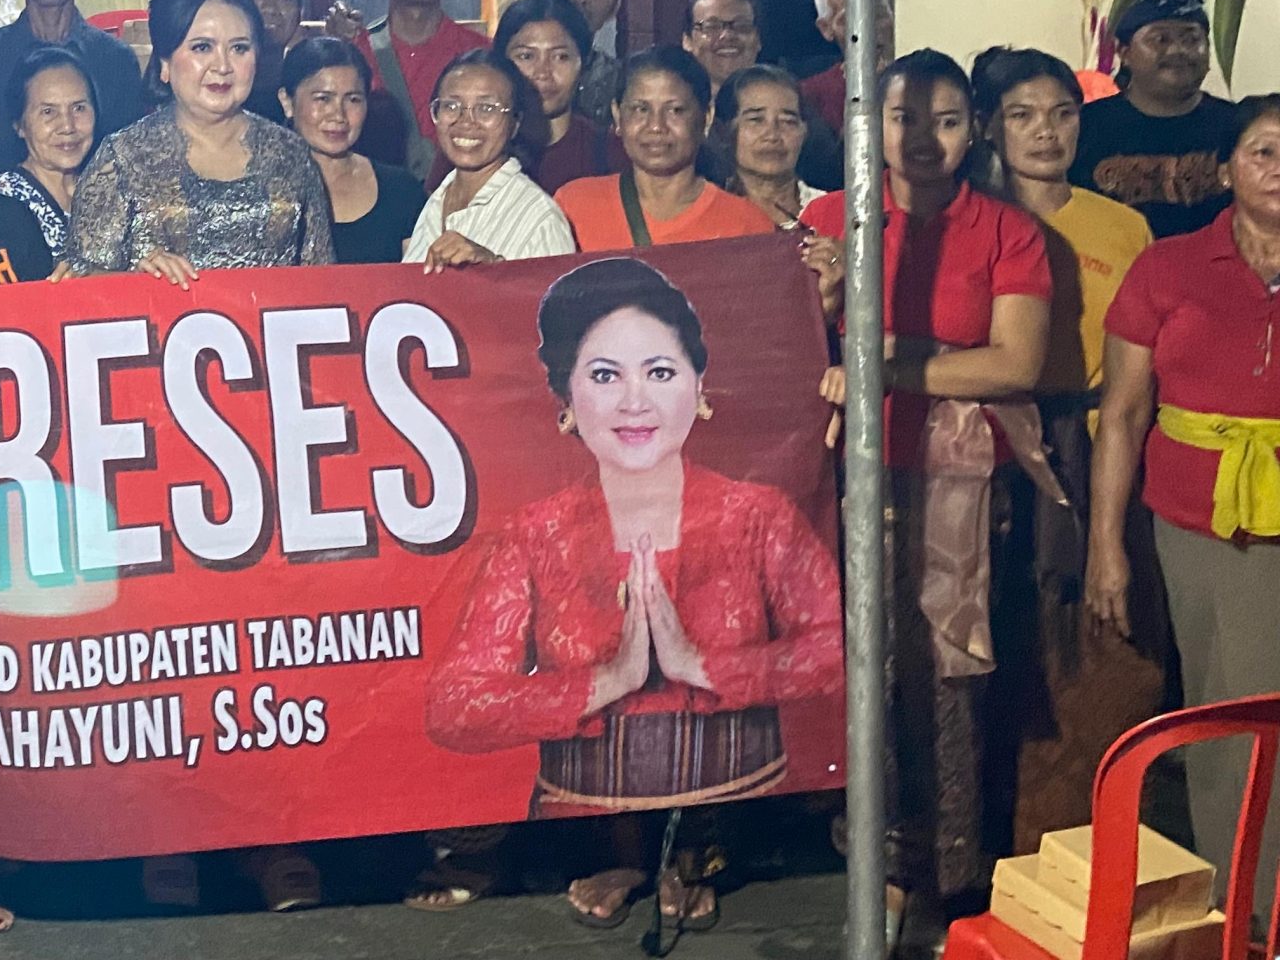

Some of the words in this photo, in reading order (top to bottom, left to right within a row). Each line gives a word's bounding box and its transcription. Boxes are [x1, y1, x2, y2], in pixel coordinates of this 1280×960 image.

[32, 623, 237, 692] KABUPATEN
[248, 609, 420, 667] TABANAN
[216, 685, 325, 751] S.Sos
